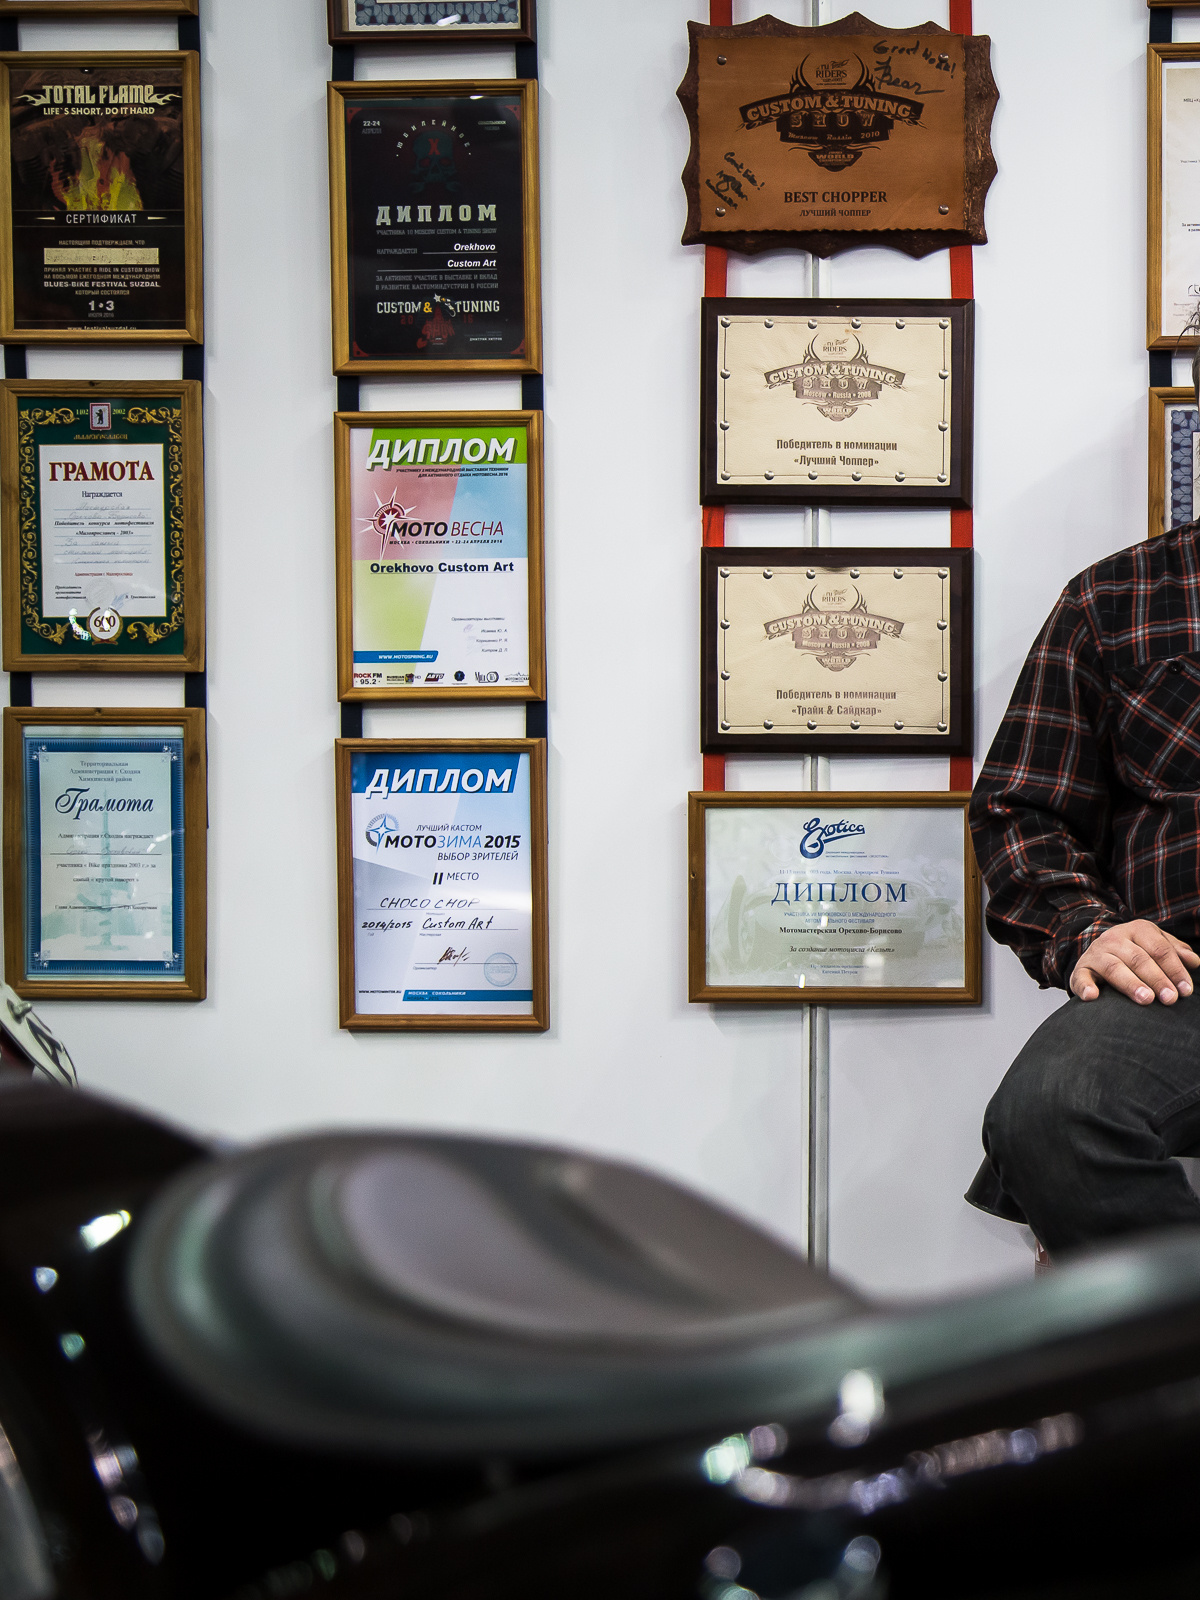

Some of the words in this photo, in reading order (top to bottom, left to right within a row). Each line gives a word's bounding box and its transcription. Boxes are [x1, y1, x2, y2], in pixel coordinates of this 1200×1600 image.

[816, 70, 848, 78] RIDERS
[42, 84, 96, 104] TOTAL
[99, 84, 155, 104] FLAME
[71, 108, 103, 116] SHORT,
[130, 107, 155, 115] HARD
[747, 96, 822, 121] CUSTOM
[825, 96, 839, 108] &
[842, 96, 912, 118] TUNING
[790, 112, 875, 128] SHOW
[860, 130, 880, 139] 2010
[784, 191, 819, 203] BEST
[822, 190, 888, 203] CHOPPER
[376, 204, 497, 226] ДИПЛОМ
[800, 208, 837, 217] ЛУЧШИЙ
[838, 209, 871, 217] ЧОППЕР
[66, 214, 137, 224] СЕРТИФИКАТ
[454, 243, 496, 251] Orekhovo
[448, 259, 481, 268] Custom
[482, 259, 497, 267] Art
[376, 302, 421, 314] CUSTOM
[424, 302, 432, 313] &
[455, 300, 500, 313] TUNING
[769, 362, 828, 385] CUSTOM
[830, 362, 844, 376] &
[843, 362, 896, 383] TUNING
[802, 377, 870, 389] SHOW
[832, 391, 852, 399] Russia
[776, 439, 833, 450] Победитель
[844, 441, 898, 452] номинации
[366, 438, 517, 471] ДИПЛОМ
[794, 456, 837, 467] «Лучший
[840, 456, 879, 467] Чоппер»
[49, 460, 155, 482] ГРАМОТА
[82, 491, 123, 499] Награждается
[390, 522, 449, 537] МОТО
[451, 521, 504, 537] ВЕСНА
[370, 562, 434, 573] Orekhovo
[438, 562, 489, 573] Custom
[494, 562, 514, 572] Art
[768, 612, 827, 634] CUSTOM
[828, 613, 843, 626] &
[842, 612, 894, 633] TUNING
[776, 689, 832, 700] Победитель
[843, 691, 897, 701] номинации
[792, 705, 824, 716] «Трайк
[826, 706, 834, 715] &
[836, 705, 882, 717] Сайдкар»
[365, 768, 513, 800] ДИПЛОМ
[55, 788, 154, 820] Грамота
[416, 824, 449, 832] ЛУЧШИЙ
[451, 824, 482, 832] КАСТОМ
[385, 835, 482, 849] МОТОЗИМА
[484, 835, 522, 849] 2015
[800, 817, 866, 859] Exotica
[437, 853, 470, 861] ВЫБОР
[472, 851, 519, 861] ЗРИТЕЛЕЙ
[446, 872, 480, 881] МЕСТО
[771, 882, 908, 906] ДИПЛОМ
[380, 897, 431, 909] CHOCO
[362, 919, 413, 932] 2014/2015
[422, 917, 466, 930] Custom
[780, 927, 837, 935] Мотомастерская
[838, 926, 903, 935] Орехово-Борисово
